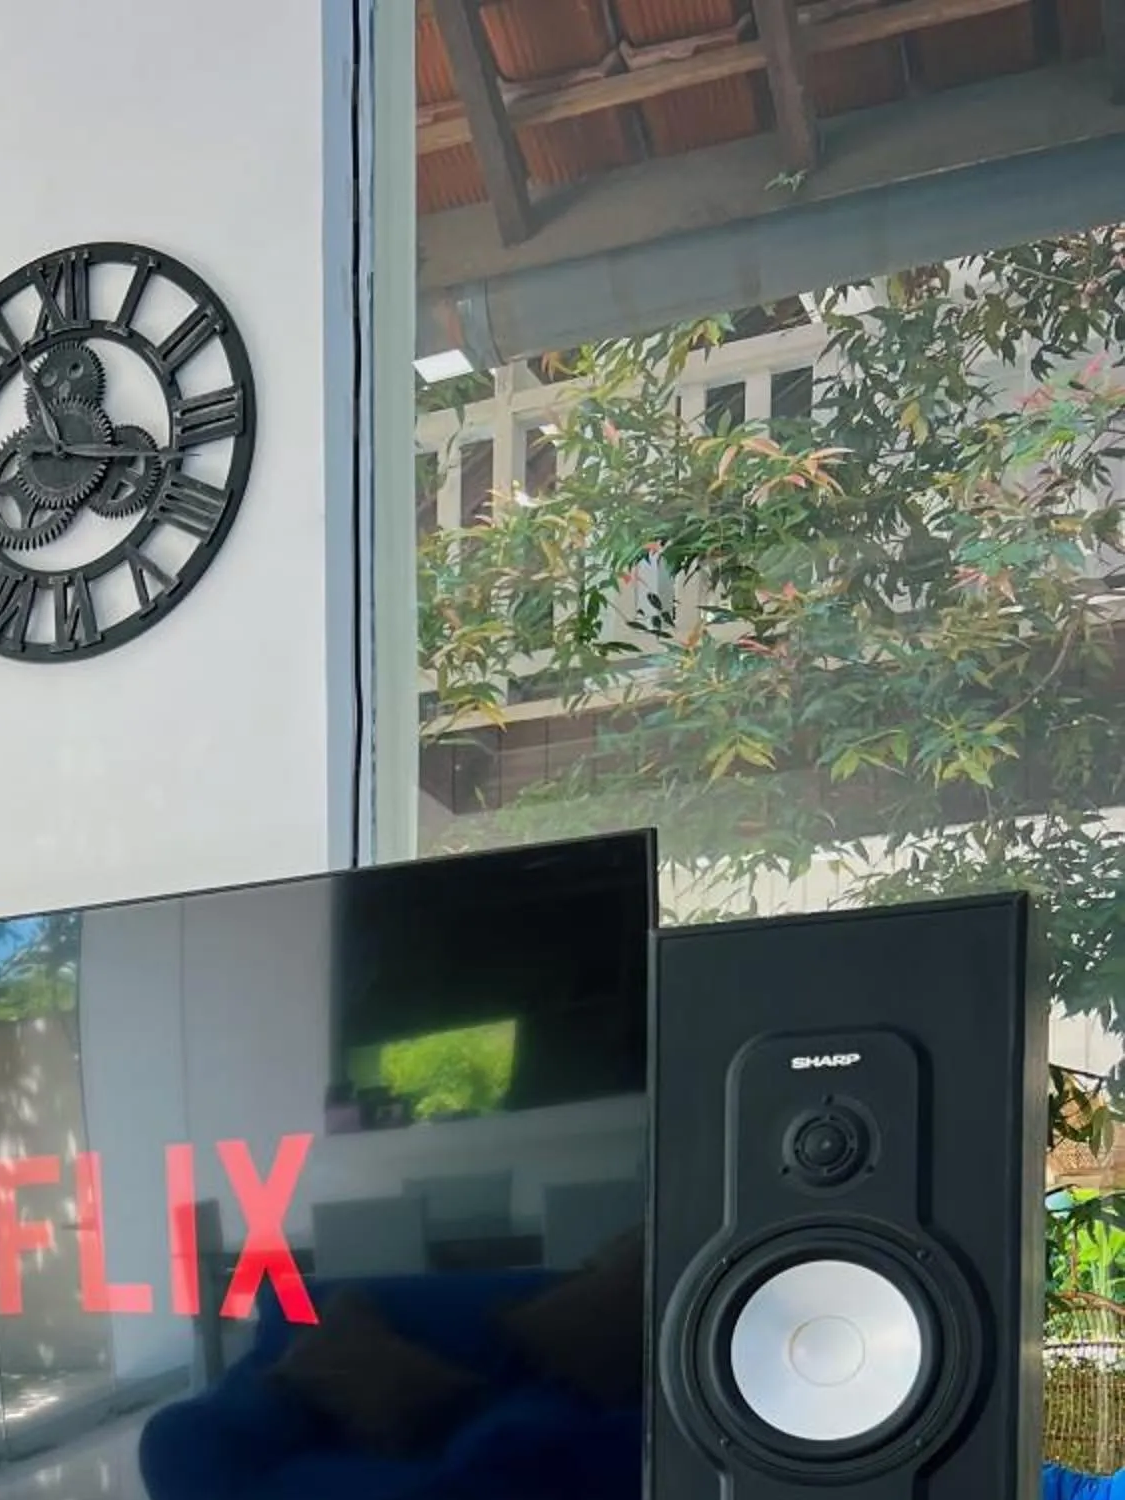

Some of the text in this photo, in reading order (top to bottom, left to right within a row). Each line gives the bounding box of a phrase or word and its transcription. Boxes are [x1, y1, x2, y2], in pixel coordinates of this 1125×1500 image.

[28, 249, 91, 341] XII
[105, 251, 159, 336] I
[153, 304, 225, 373] II
[175, 385, 244, 447] III
[791, 1053, 861, 1069] SHARP
